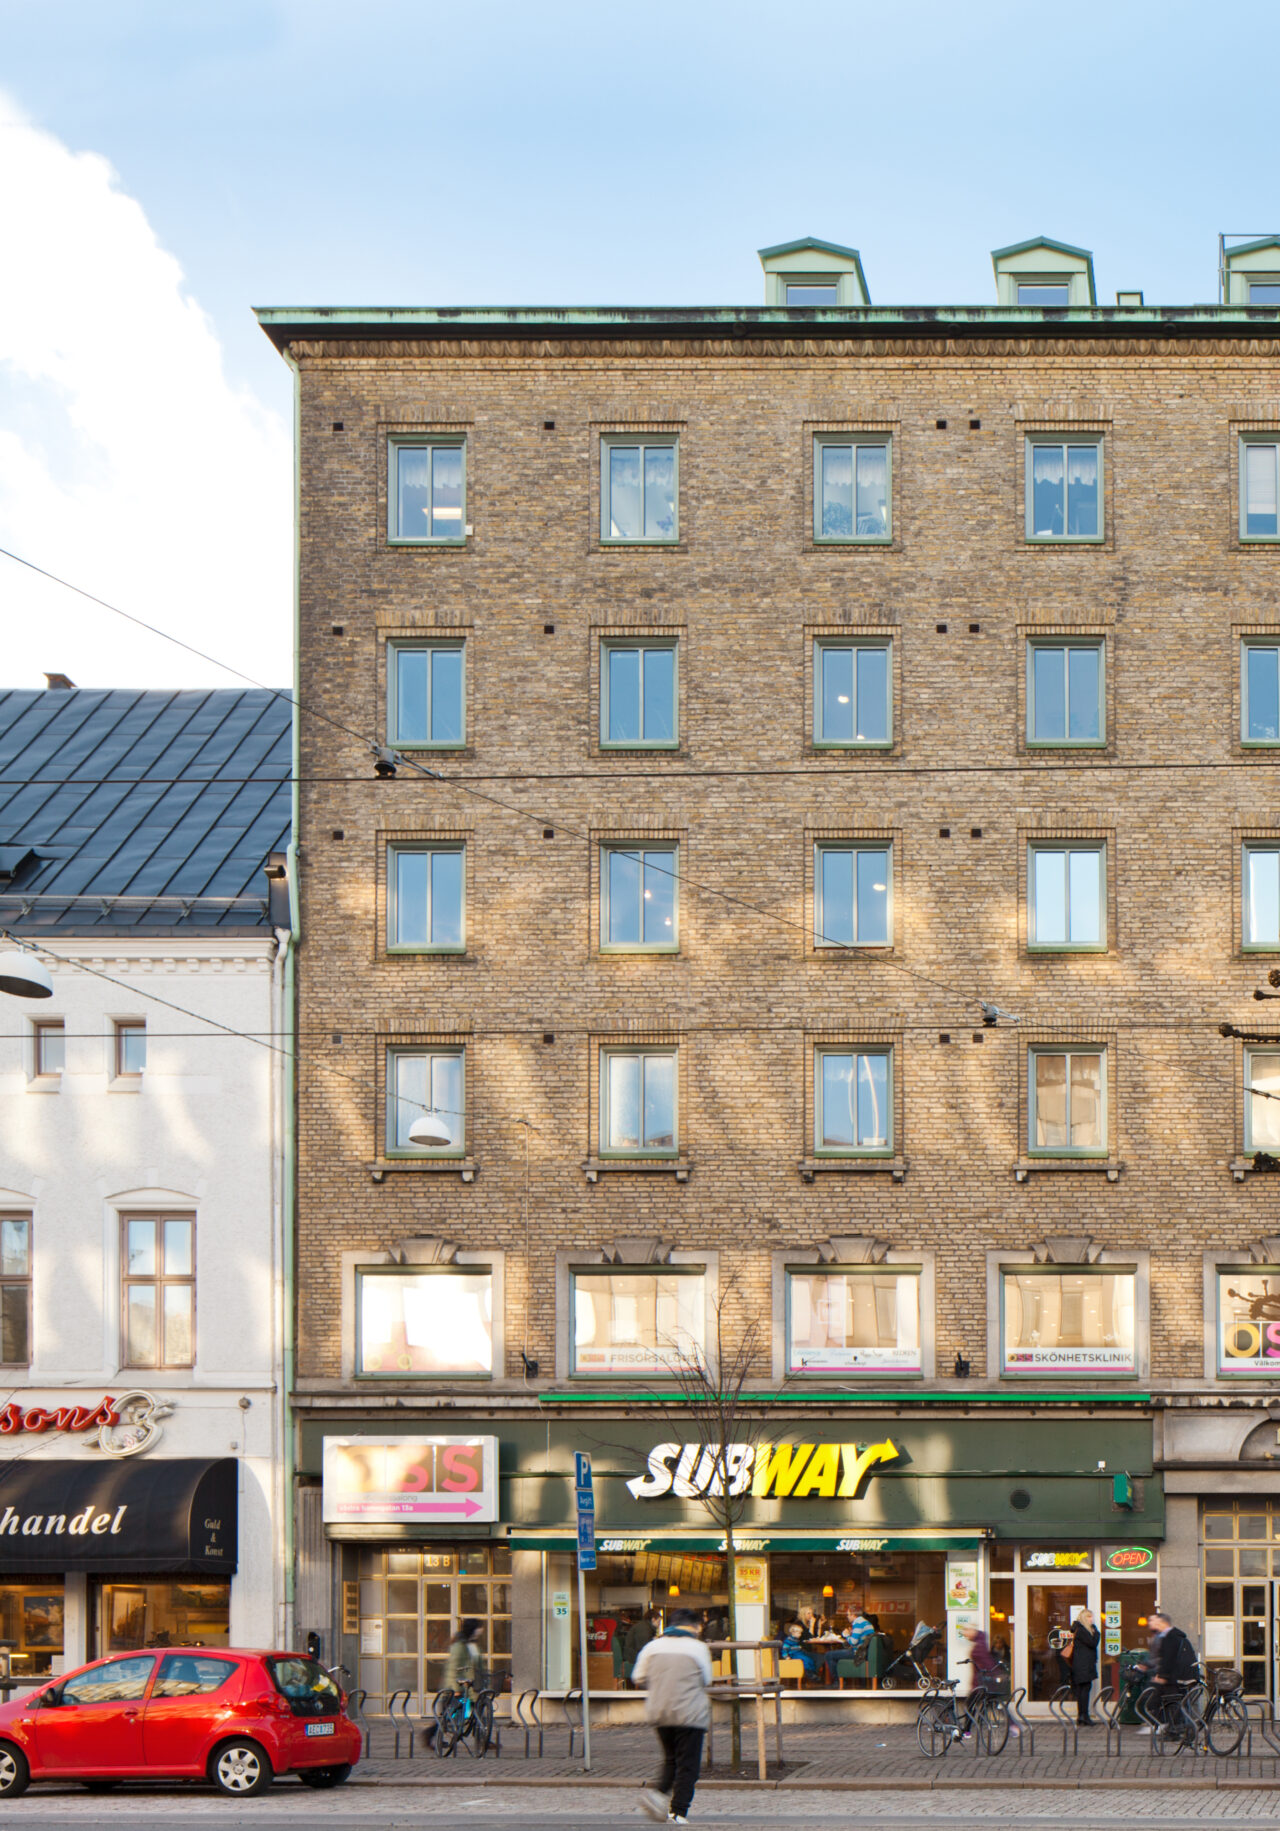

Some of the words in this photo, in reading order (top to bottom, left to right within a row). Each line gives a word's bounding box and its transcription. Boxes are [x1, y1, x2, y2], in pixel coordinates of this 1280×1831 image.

[1034, 1351, 1132, 1363] SKÖNHETSKLINIK
[580, 1455, 589, 1486] P
[626, 1438, 900, 1500] SUBWAY
[0, 1505, 128, 1535] handel
[600, 1539, 652, 1551] SUBWAY
[718, 1539, 770, 1551] SBWAY
[836, 1539, 888, 1551] SUBWAY
[426, 1555, 440, 1567] 13
[443, 1555, 450, 1567] B
[1026, 1552, 1088, 1567] SUBWAY
[1111, 1552, 1147, 1566] OPEN
[556, 1607, 567, 1616] 35
[1108, 1616, 1119, 1624] 35
[1108, 1644, 1119, 1652] 50
